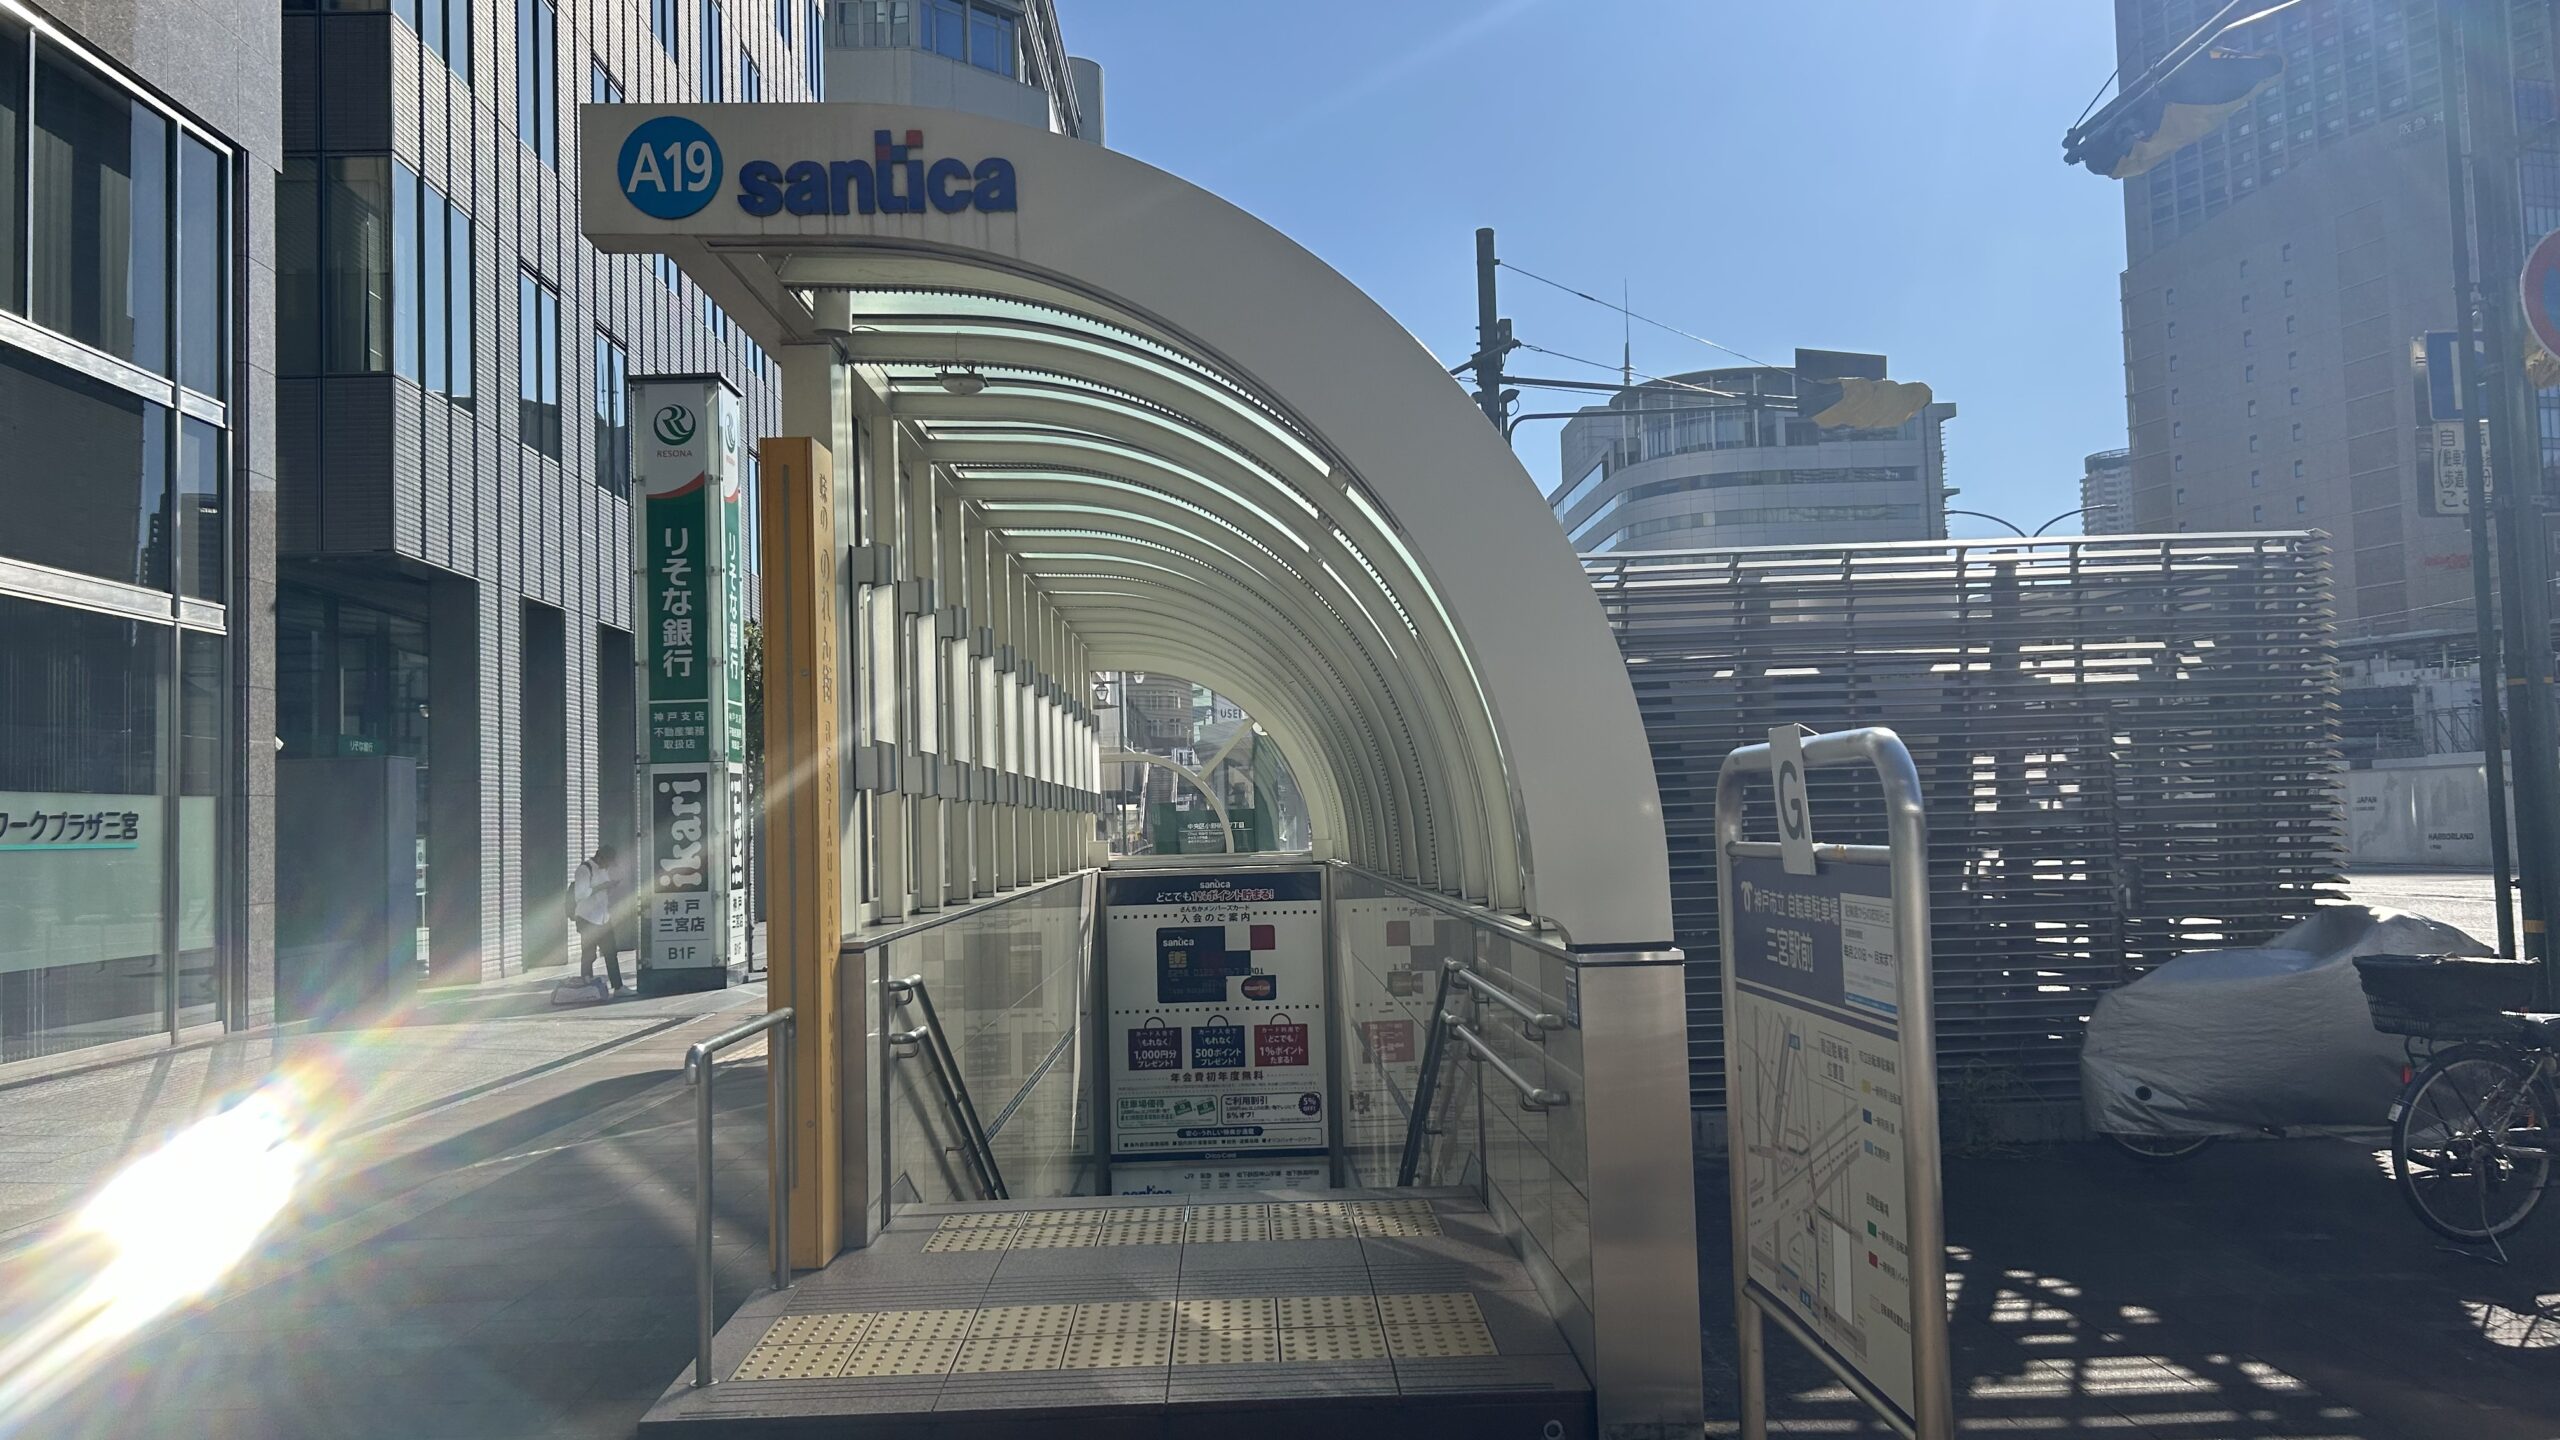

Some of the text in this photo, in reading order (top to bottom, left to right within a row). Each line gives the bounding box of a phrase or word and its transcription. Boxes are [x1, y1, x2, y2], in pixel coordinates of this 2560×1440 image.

[628, 140, 713, 194] A19
[737, 129, 1018, 217] santica
[656, 450, 693, 458] RESONA
[662, 527, 693, 678] りそな銀行
[654, 711, 705, 722] 神戸支店
[654, 726, 705, 737] 不動産業務
[663, 739, 696, 749] 取扱店
[1779, 759, 1806, 841] G
[658, 779, 702, 887] ikari
[730, 779, 743, 886] ikari
[825, 720, 835, 980] RESTAURANT
[663, 899, 701, 915] 神戸
[1753, 887, 1786, 919] 神戸市立
[659, 917, 705, 932] 三宮店
[1180, 912, 1251, 924] 入会のご案内
[668, 947, 696, 960] B1F
[1766, 926, 1814, 973] 三宮駅前
[1142, 1038, 1168, 1046] もれなく
[1205, 1037, 1231, 1045] もれなく
[1134, 1050, 1177, 1060] 1,000円分
[1195, 1048, 1242, 1059] 500ポイント
[1260, 1046, 1304, 1056] 1%ポイント
[1170, 1070, 1264, 1083] 年会費初年度無料
